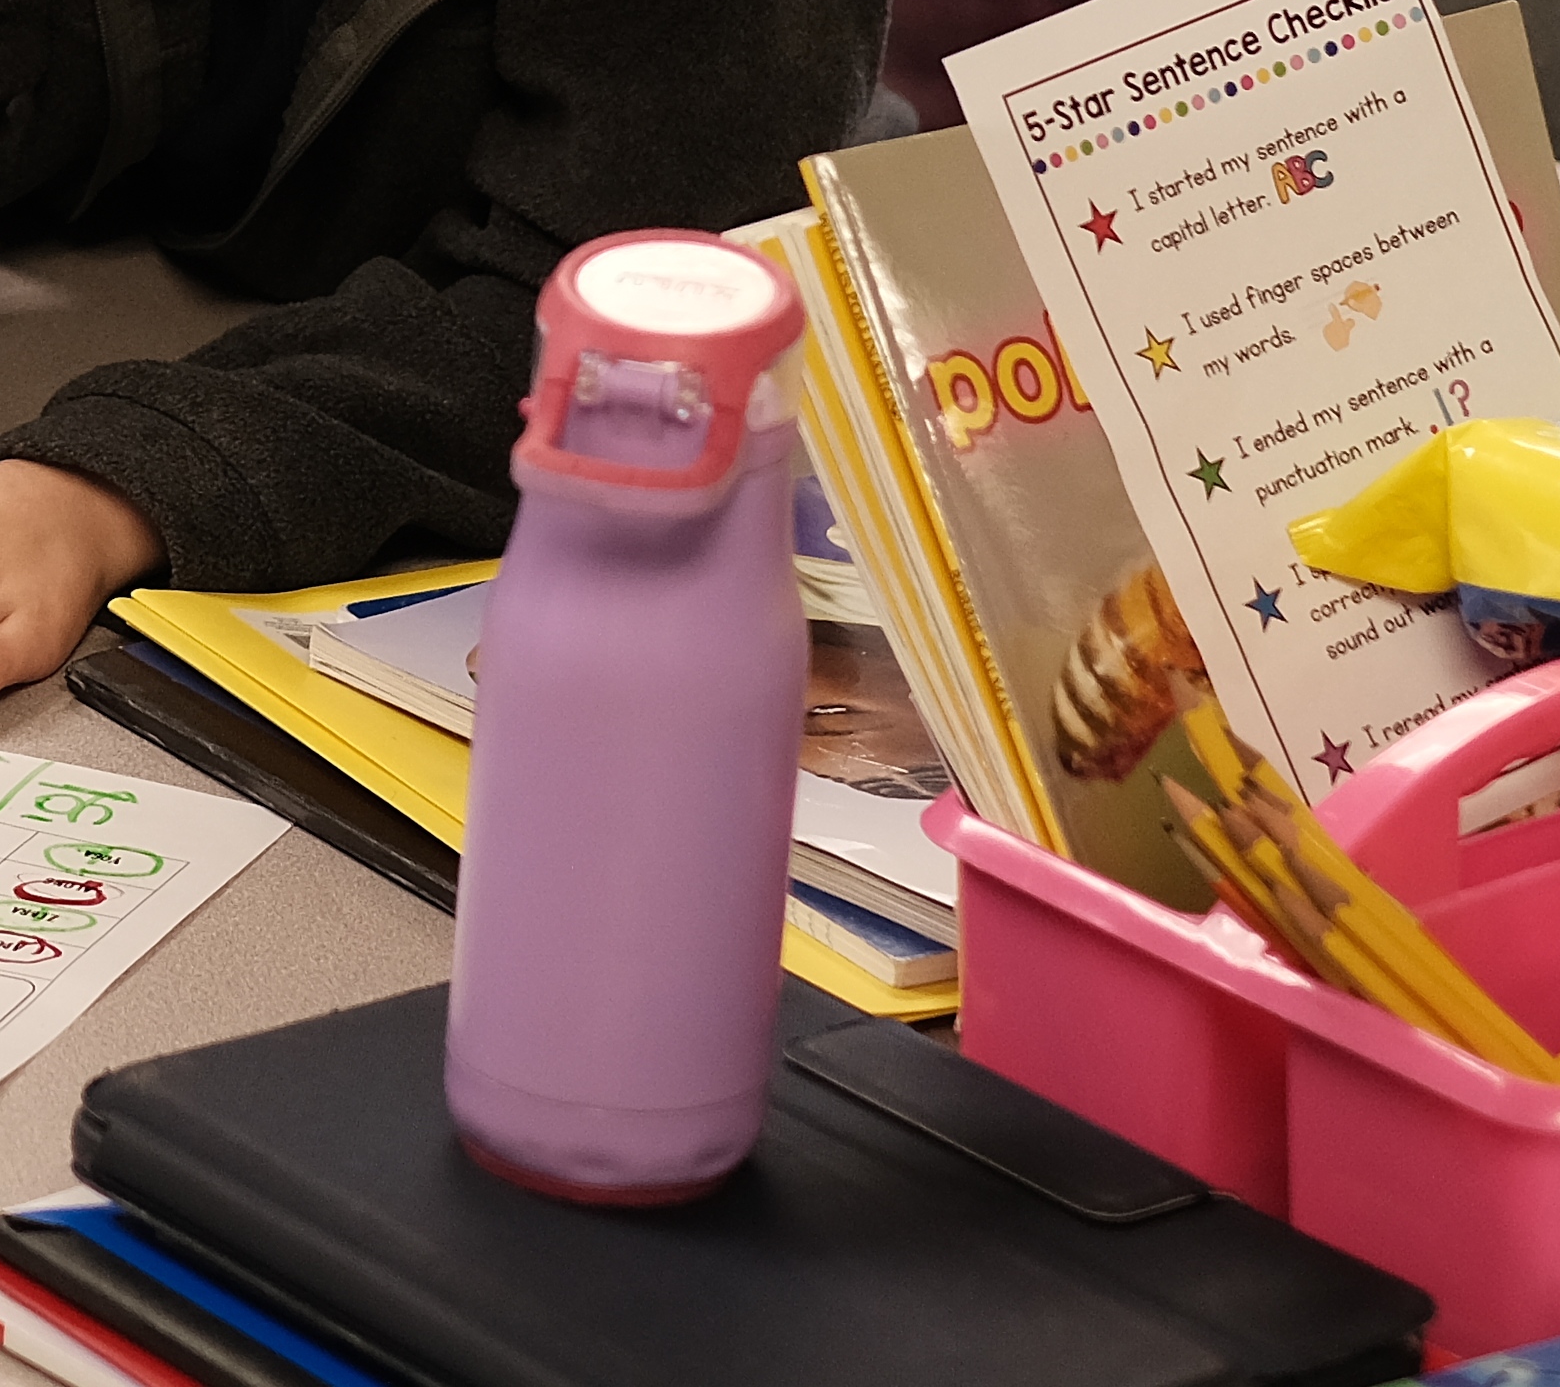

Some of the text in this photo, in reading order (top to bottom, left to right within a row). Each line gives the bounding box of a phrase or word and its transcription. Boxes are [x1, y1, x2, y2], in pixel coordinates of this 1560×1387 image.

[1022, 84, 1115, 142] 5-Star
[1122, 30, 1262, 103] Sentence
[1127, 89, 1407, 212] I started my sentence with a
[1150, 149, 1334, 252] capital letter. ABC
[1181, 208, 1460, 336] I used finger spaces between
[1202, 325, 1297, 379] my words.
[1232, 338, 1494, 460] I ended my sentence with a
[1253, 444, 1363, 508] punctuation
[1364, 416, 1420, 453] mark.
[1288, 562, 1307, 587] I
[1325, 616, 1380, 661] sound
[1383, 605, 1415, 634] out
[1361, 723, 1380, 749] I
[1382, 692, 1447, 741] reread
[83, 849, 122, 866] YOGA
